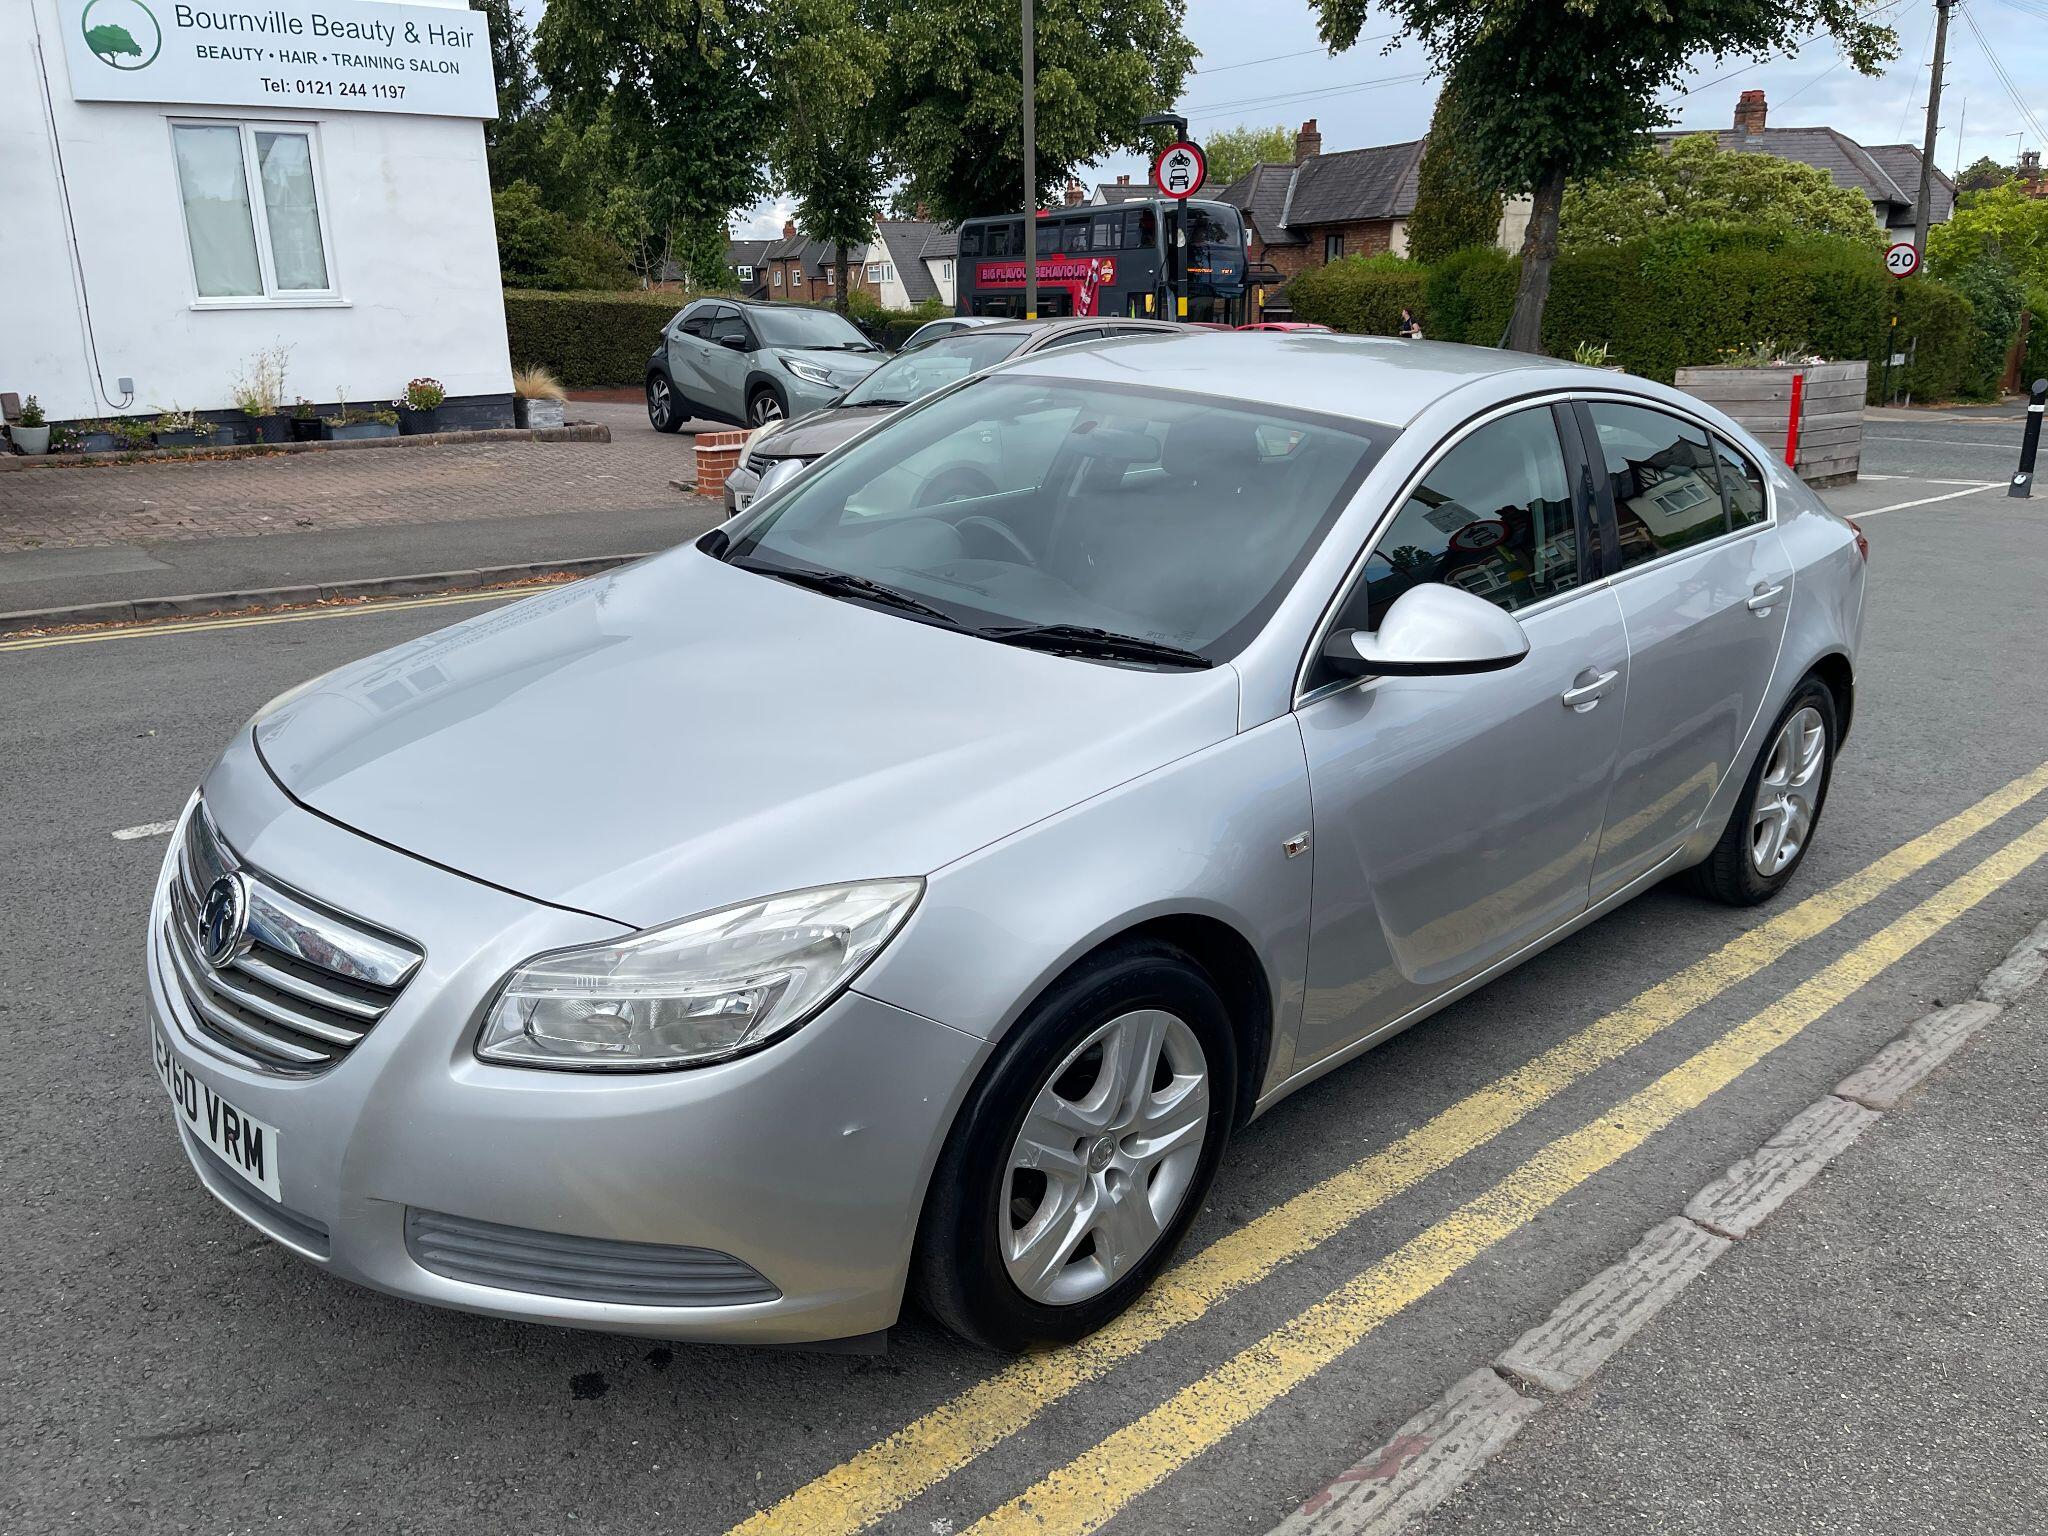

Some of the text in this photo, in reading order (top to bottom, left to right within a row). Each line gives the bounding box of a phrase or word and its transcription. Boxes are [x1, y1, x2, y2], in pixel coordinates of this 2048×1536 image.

[175, 4, 474, 48] Bournville Beauty & Hair
[196, 45, 460, 75] BEAUTY HAIR TRAINING SALON
[260, 78, 405, 100] Tel: 0121 244 1197
[982, 268, 995, 280] BIG
[996, 267, 1027, 279] FLAVOU
[1035, 265, 1087, 278] BEHAVIOUR
[1889, 253, 1914, 267] 20
[204, 1082, 265, 1181] VRM
